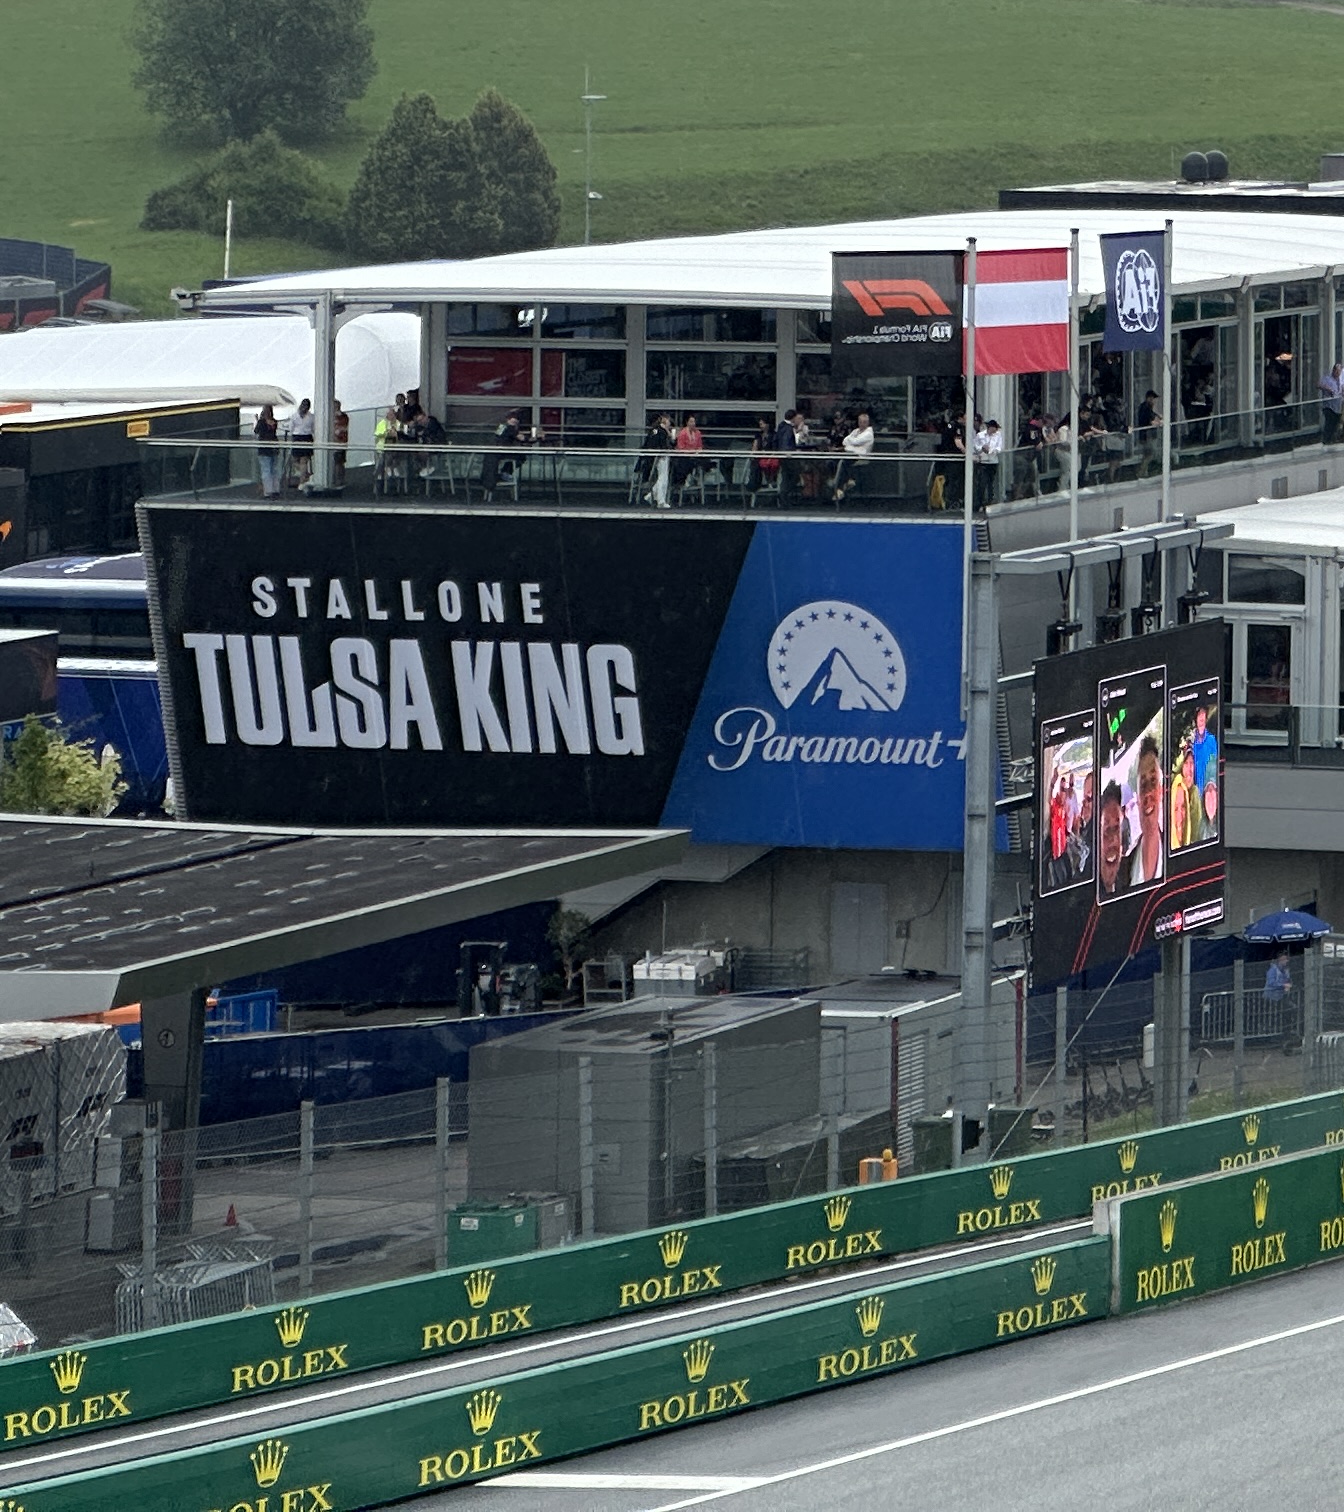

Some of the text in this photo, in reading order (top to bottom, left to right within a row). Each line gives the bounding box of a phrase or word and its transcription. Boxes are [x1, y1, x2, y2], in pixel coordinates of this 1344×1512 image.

[252, 577, 544, 624] STALLONE
[184, 632, 644, 756] TULSA KING
[1219, 1145, 1281, 1172] ROLEX
[956, 1200, 1041, 1234] ROLEX
[786, 1230, 882, 1269] ROLEX
[1231, 1233, 1286, 1275] ROLEX
[619, 1265, 722, 1308] ROLEX
[1136, 1257, 1195, 1302] ROLEX
[421, 1304, 532, 1350] ROLEX
[996, 1293, 1088, 1336] ROLEX
[231, 1345, 348, 1392] ROLEX
[817, 1334, 918, 1382] ROLEX
[4, 1389, 132, 1441] ROLEX
[639, 1379, 750, 1430] ROLEX
[418, 1431, 542, 1486] ROLEX
